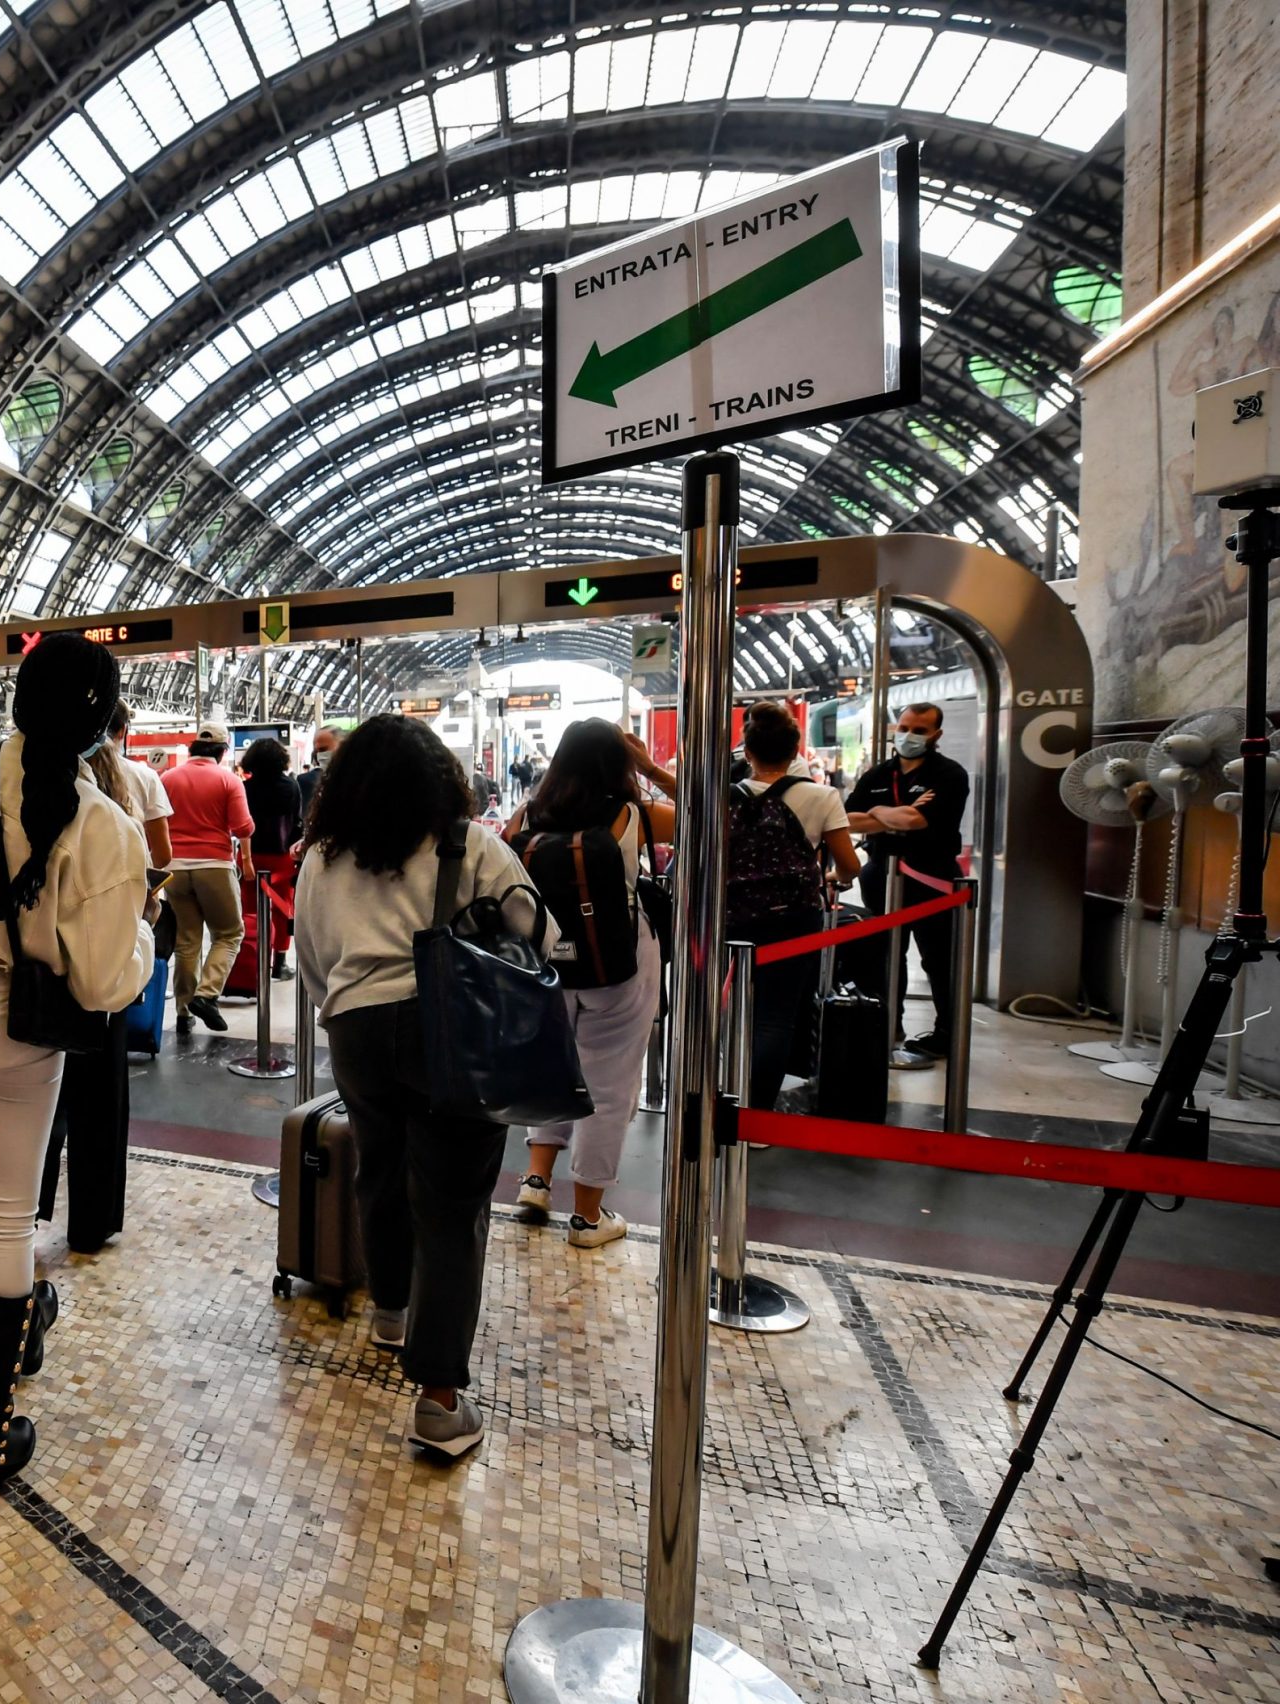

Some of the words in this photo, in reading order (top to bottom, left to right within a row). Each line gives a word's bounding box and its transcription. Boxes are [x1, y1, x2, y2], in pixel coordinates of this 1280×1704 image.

[574, 242, 692, 299] ENTRATA
[722, 193, 819, 247] ENTRY
[605, 412, 679, 447] TRENI
[709, 378, 815, 421] TRAINS
[84, 627, 114, 643] GATE
[118, 626, 128, 640] C
[1016, 688, 1083, 707] GATE
[1021, 711, 1077, 769] C
